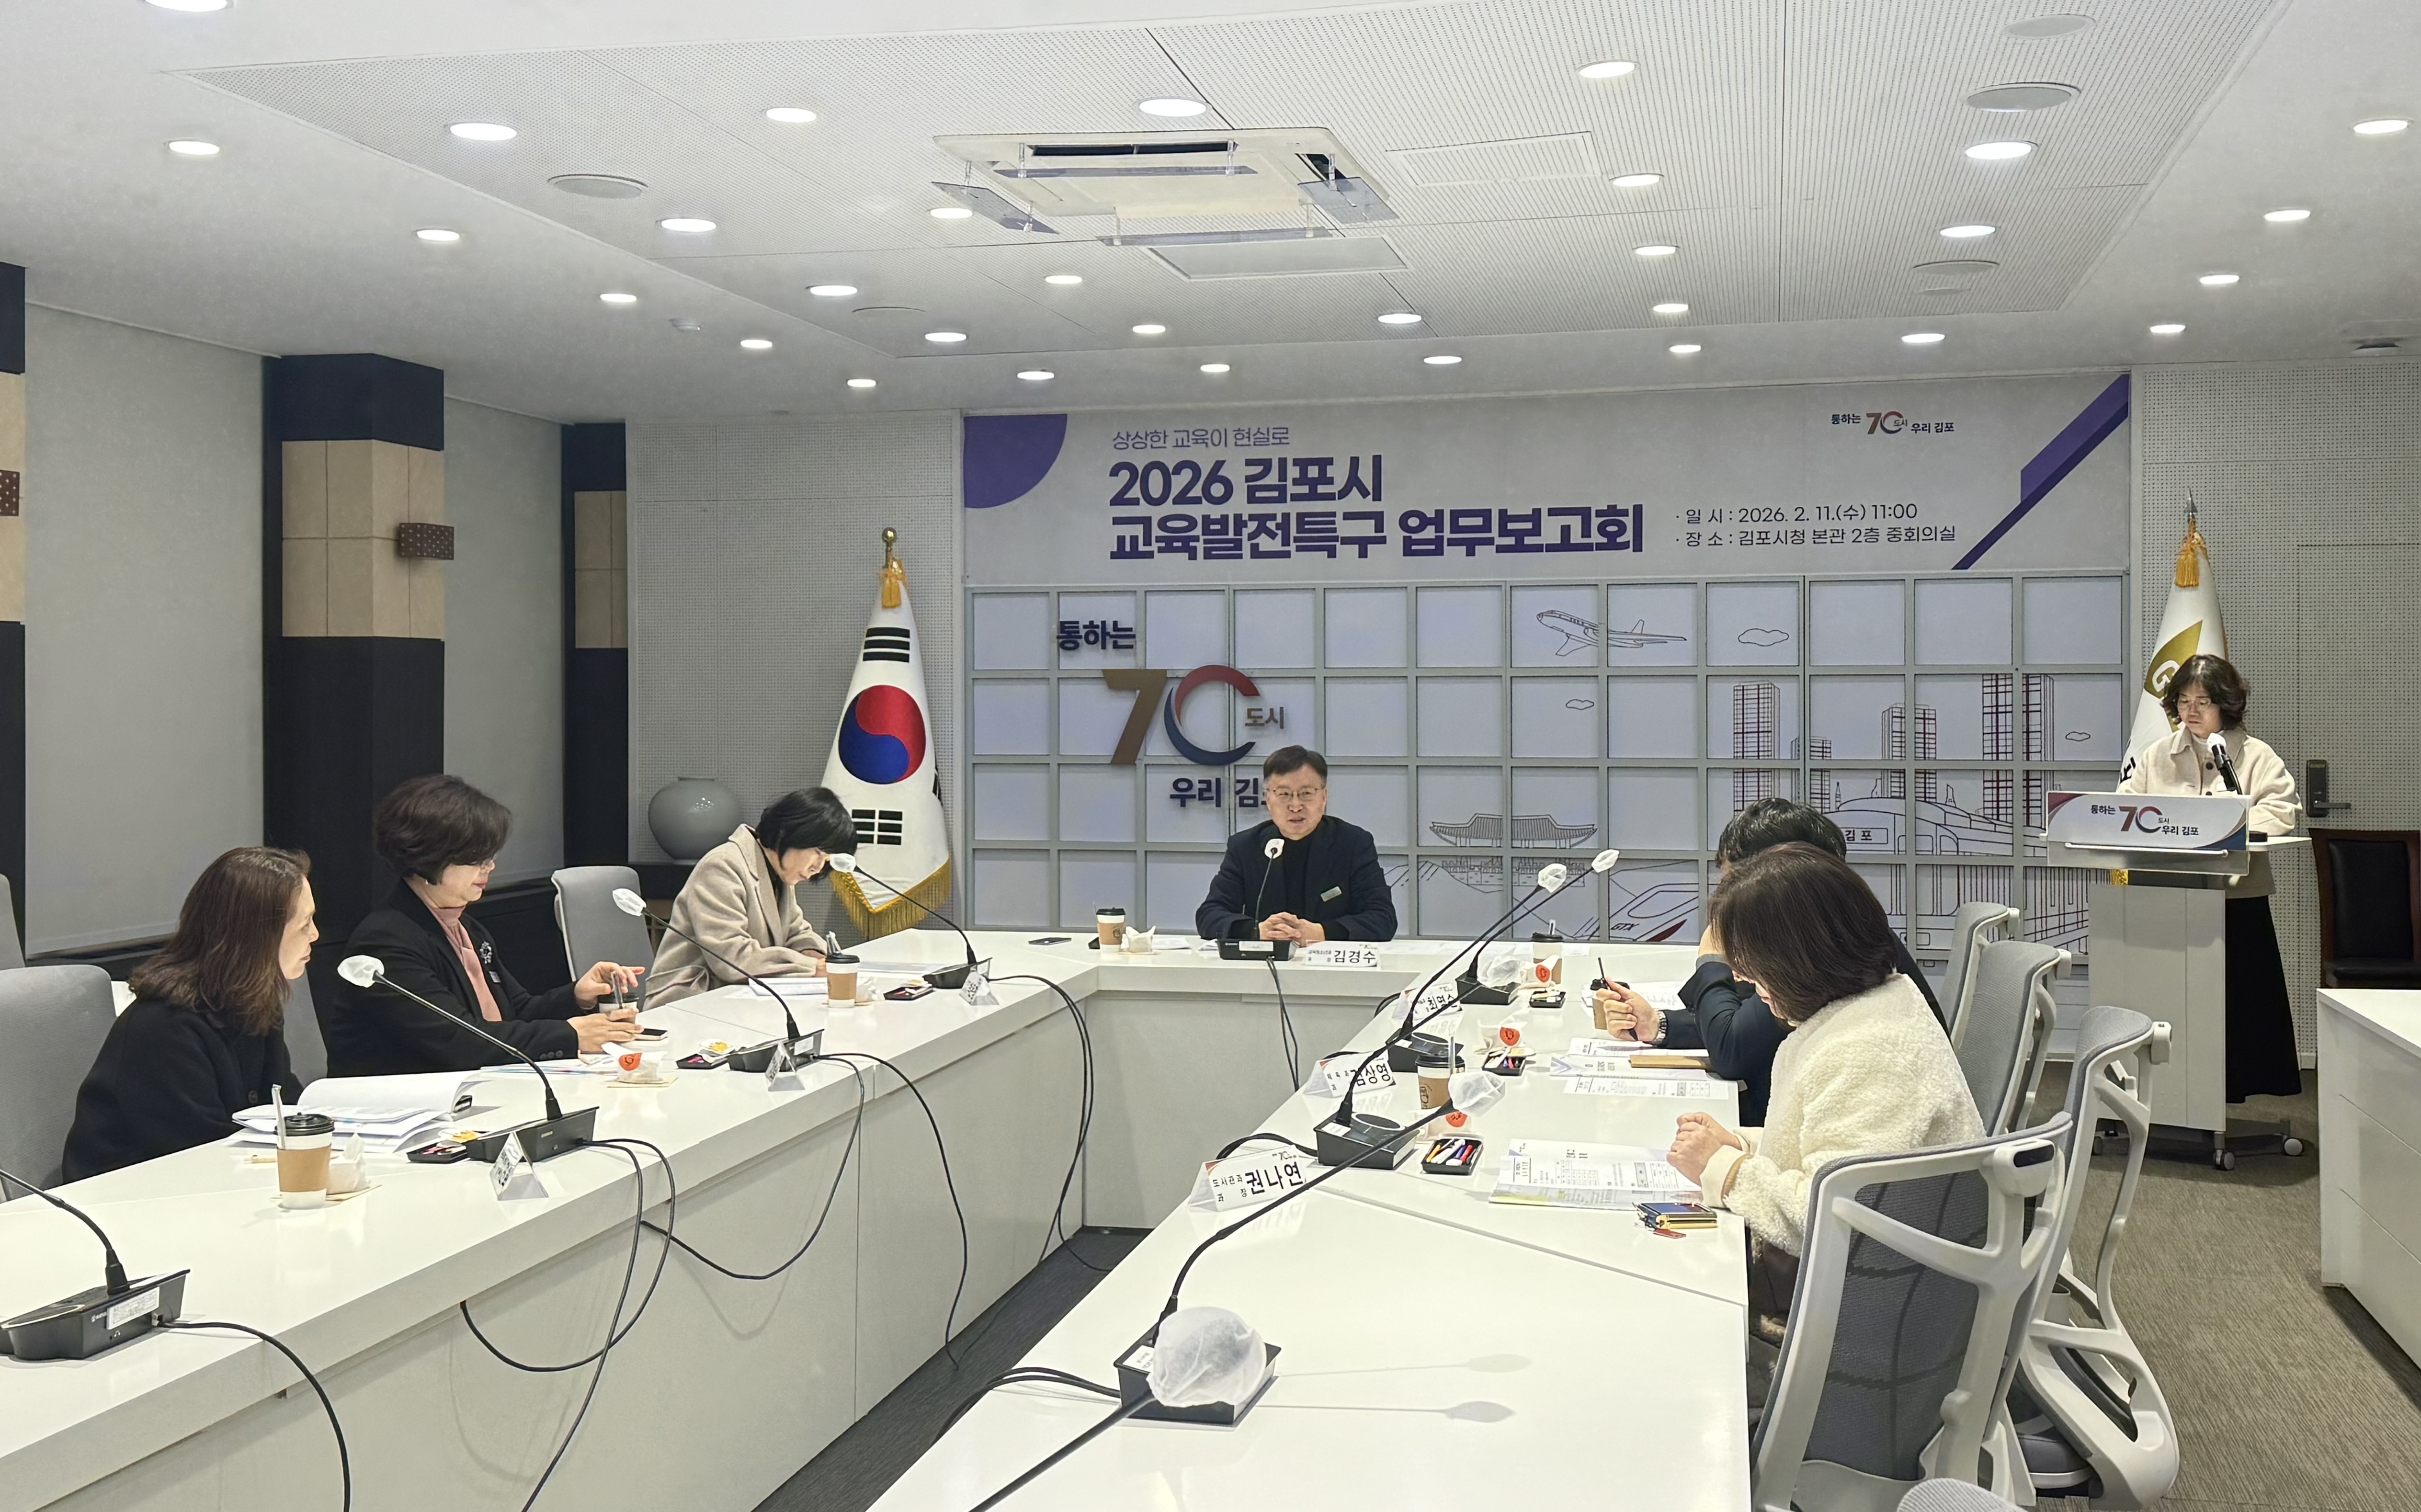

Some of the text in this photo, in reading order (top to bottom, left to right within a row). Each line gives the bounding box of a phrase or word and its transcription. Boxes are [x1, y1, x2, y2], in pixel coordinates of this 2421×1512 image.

[1831, 413, 1861, 425] 통하는
[1910, 422, 1931, 433] 우리
[1934, 422, 1955, 433] 김포
[1113, 427, 1290, 450] 상상한 교육이 현실로
[1109, 455, 1382, 506] 2026 김포시
[1739, 507, 1788, 523] 2026.
[1795, 506, 1809, 521] 2.
[1872, 503, 1917, 519] 11:00
[1110, 504, 1643, 561] 교육발전특구 업무보고회
[1739, 529, 1805, 546] 김포시청
[1812, 528, 1846, 544] 본관
[1852, 527, 1880, 543] 2층
[1887, 525, 1955, 543] 중회의실
[1056, 620, 1136, 650] 통하는
[1245, 707, 1284, 729] 도시
[1170, 778, 1267, 807] 우리 김
[2091, 805, 2116, 815] 통하는
[1845, 829, 1873, 842] 김포
[2161, 825, 2199, 836] 우리 김포
[1611, 923, 1639, 931] GTX
[1334, 950, 1376, 964] 김경수
[1245, 1161, 1304, 1195] 권나연
